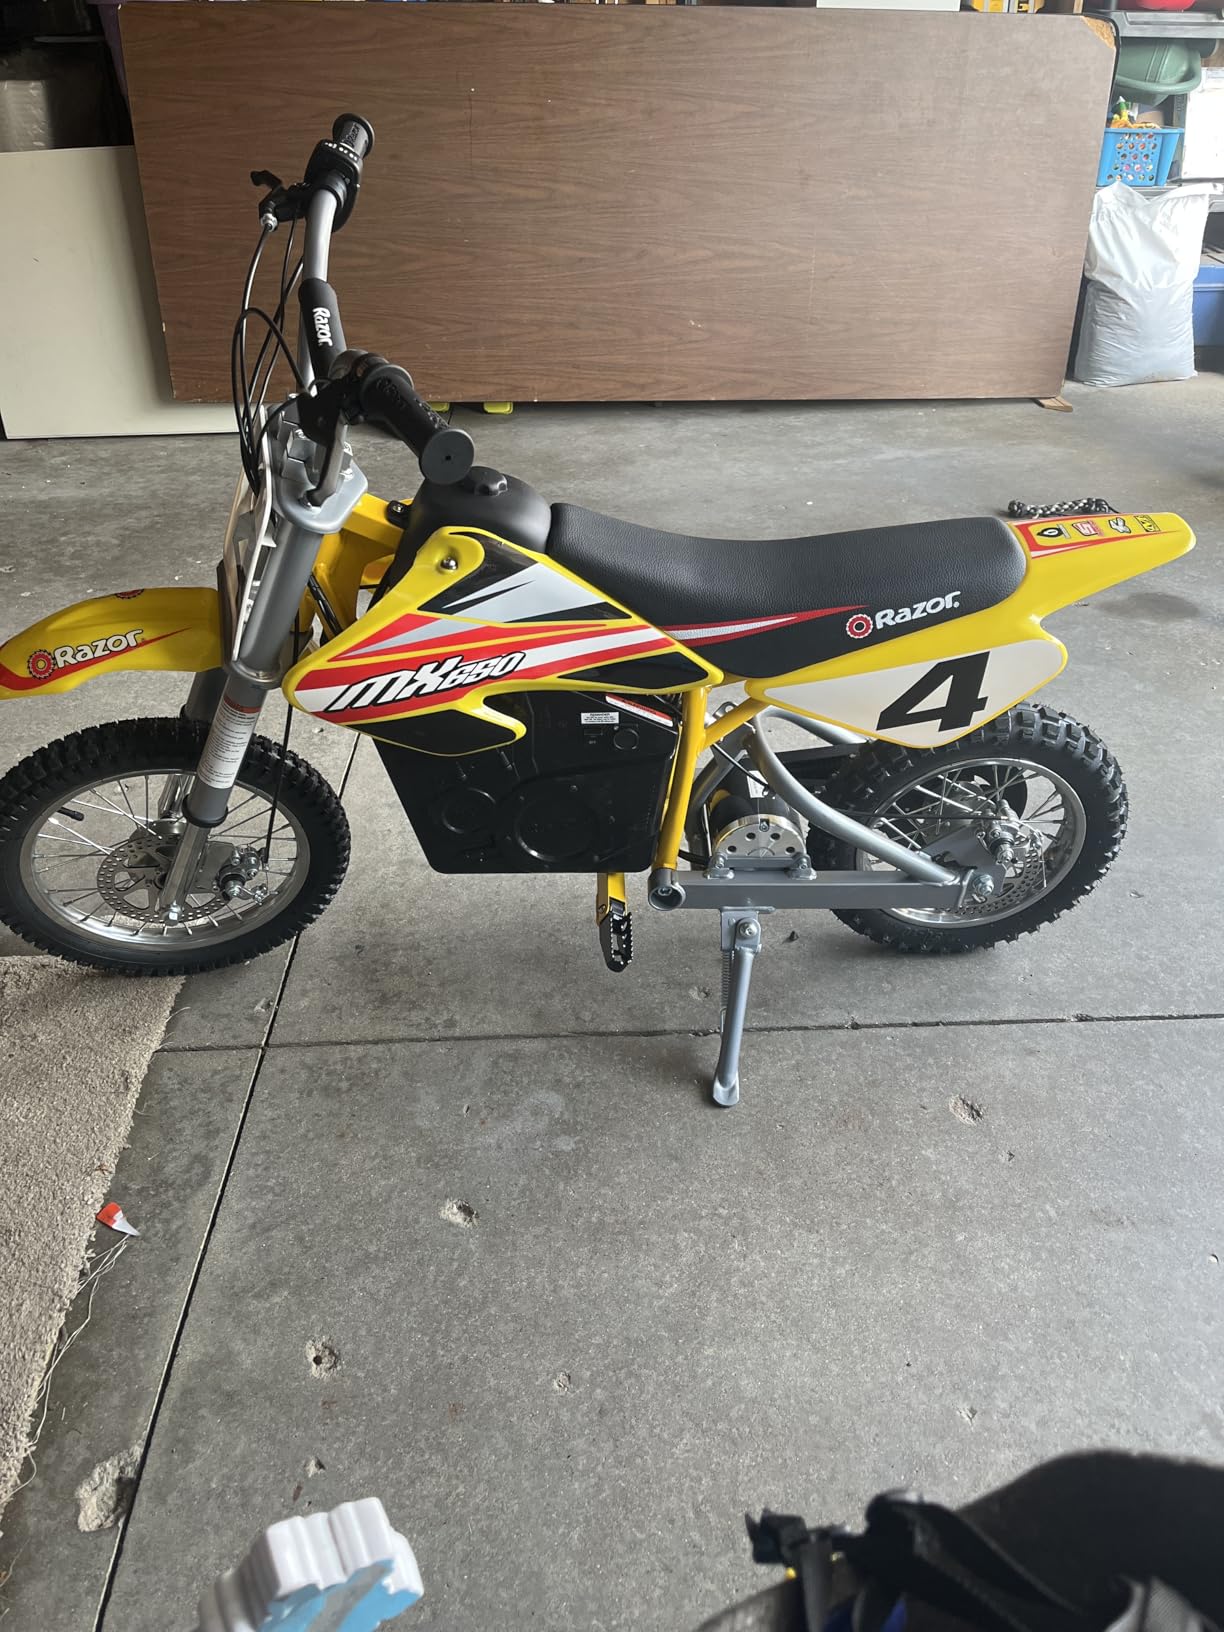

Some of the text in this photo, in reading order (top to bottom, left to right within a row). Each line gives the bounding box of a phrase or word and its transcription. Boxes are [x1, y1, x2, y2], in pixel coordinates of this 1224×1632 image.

[312, 307, 333, 347] Razor
[53, 628, 144, 669] Razor
[325, 651, 526, 713] MX650
[875, 650, 991, 733] 4
